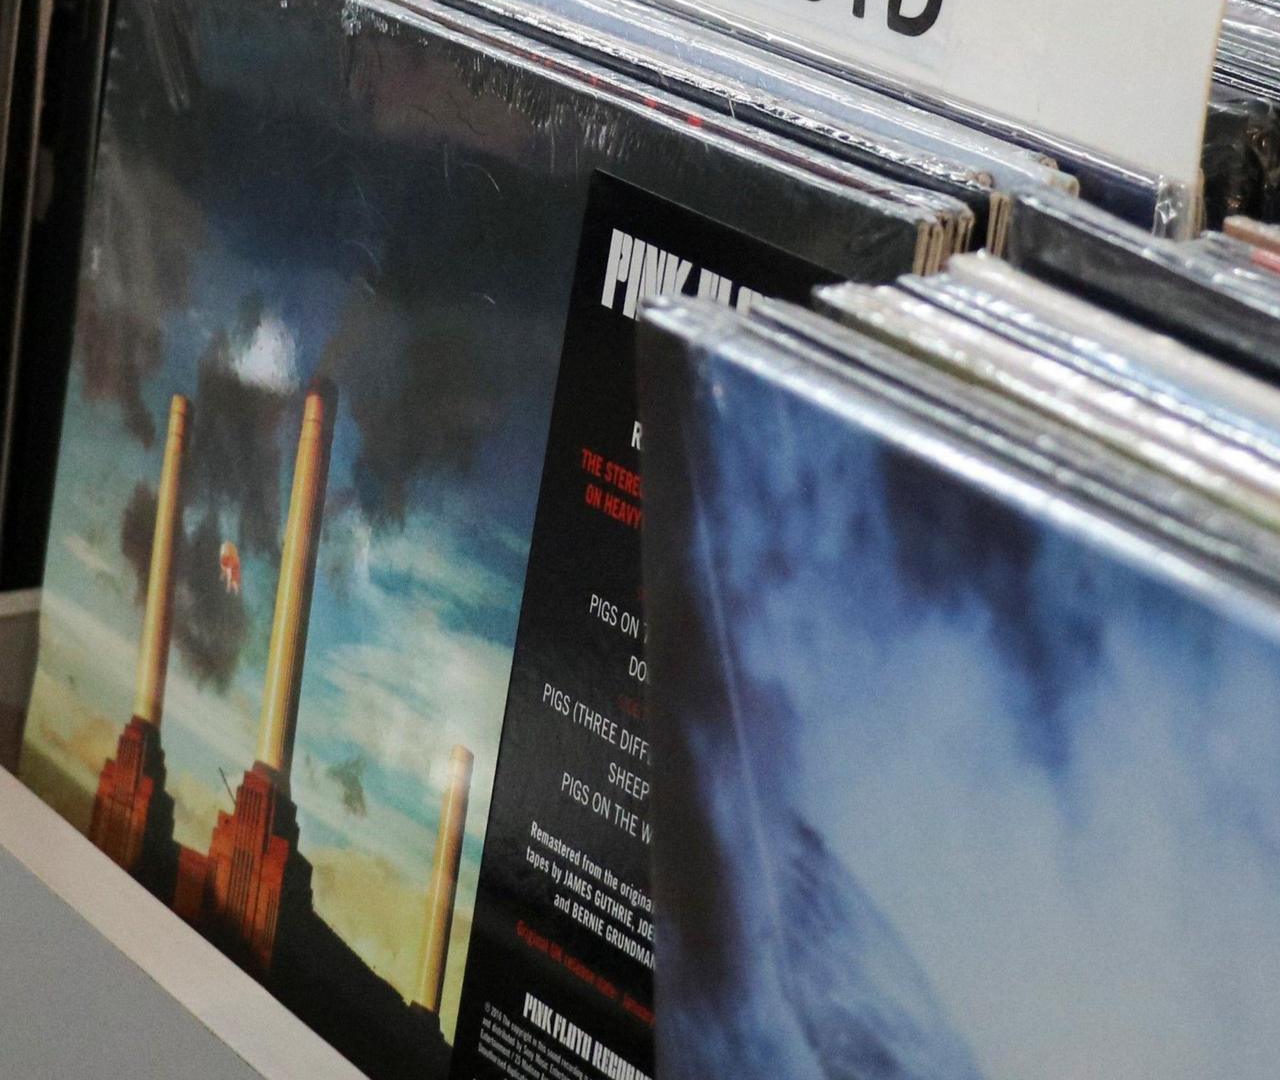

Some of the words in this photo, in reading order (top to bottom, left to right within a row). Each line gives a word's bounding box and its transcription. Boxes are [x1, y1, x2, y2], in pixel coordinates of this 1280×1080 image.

[582, 448, 605, 478] THE
[604, 461, 645, 499] STERE
[585, 483, 602, 510] ON
[603, 492, 642, 530] HEAVY
[589, 593, 618, 626] PIGS
[620, 611, 640, 639] ON
[628, 655, 649, 685] DO
[542, 682, 571, 716] PIGS
[573, 701, 618, 745] (THREE
[619, 728, 651, 765] DIFF
[561, 772, 590, 806] PIGS
[592, 792, 611, 820] ON
[613, 804, 637, 837] THE
[608, 762, 650, 801] SHEEP
[530, 820, 581, 866] Remastered
[582, 854, 602, 880] from
[604, 869, 619, 890] the
[526, 845, 550, 873] tapes
[551, 861, 563, 884] by
[563, 869, 593, 900] JAMES
[594, 890, 635, 932] GUTHRIE,
[637, 918, 655, 942] JOE
[553, 893, 571, 915] and
[571, 902, 605, 937] BERNIE
[523, 992, 553, 1035] PINK
[553, 1013, 592, 1062] FLOYD
[592, 1040, 654, 1080] RECOR
